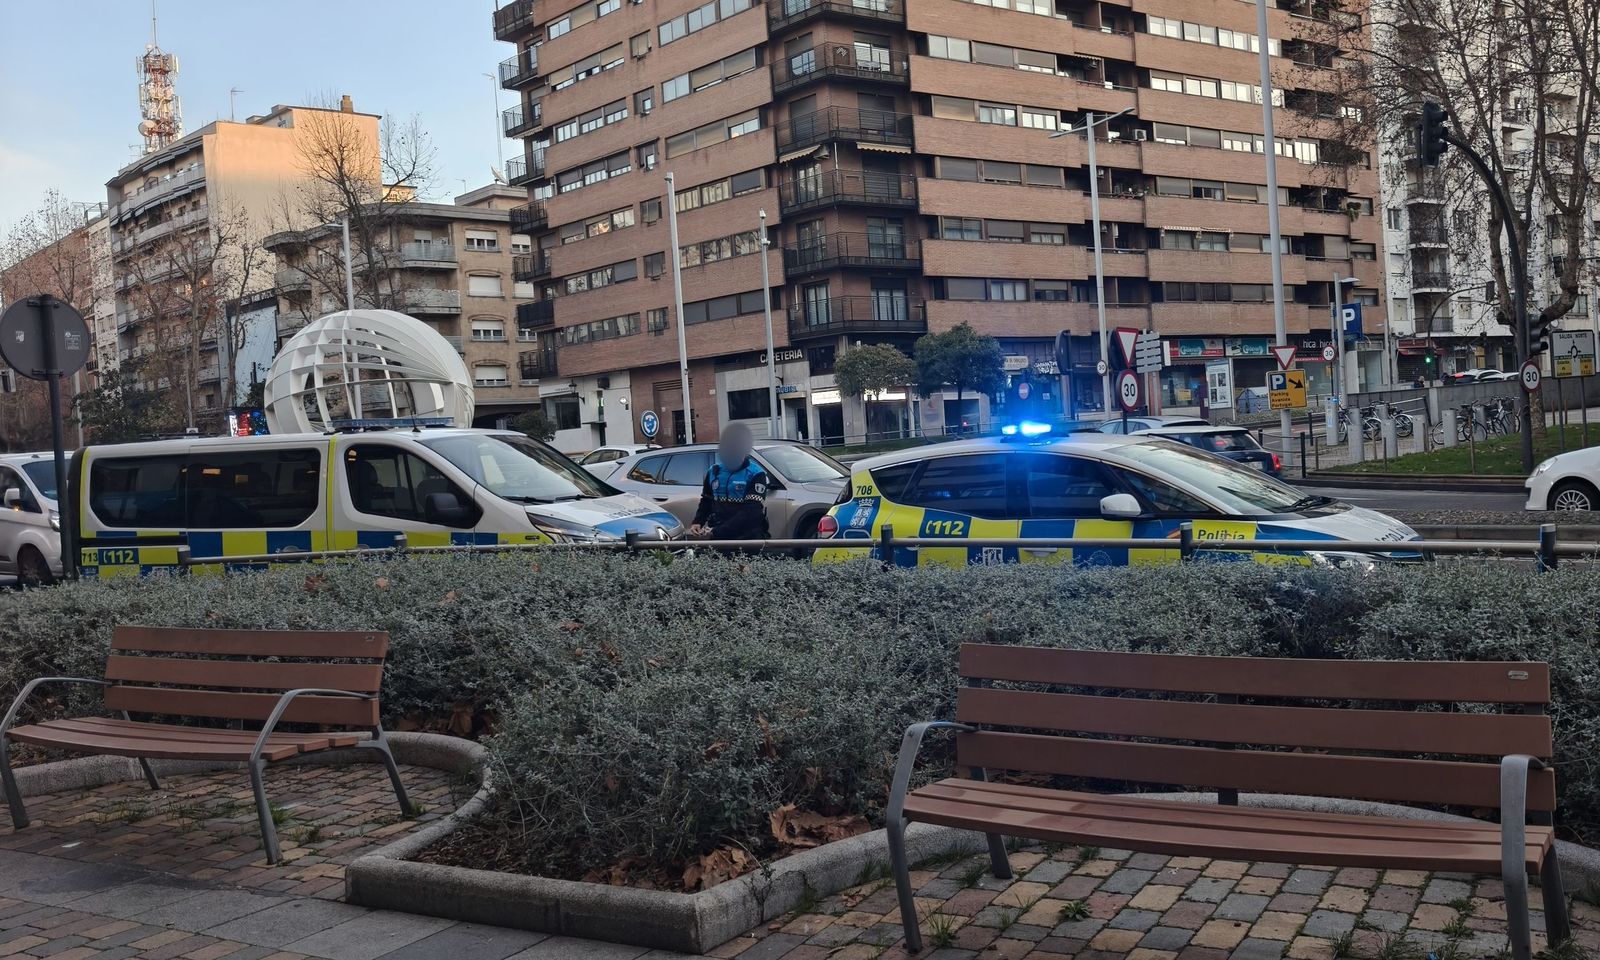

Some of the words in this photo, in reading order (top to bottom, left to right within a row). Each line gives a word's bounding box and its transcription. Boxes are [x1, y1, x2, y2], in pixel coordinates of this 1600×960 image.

[1342, 308, 1355, 331] P
[760, 349, 803, 363] CETERIA
[1271, 374, 1284, 390] P
[1525, 371, 1538, 382] 30
[1123, 383, 1136, 397] 30
[856, 485, 873, 496] 708
[932, 520, 964, 535] 112
[82, 552, 98, 563] 713
[107, 550, 134, 564] 112
